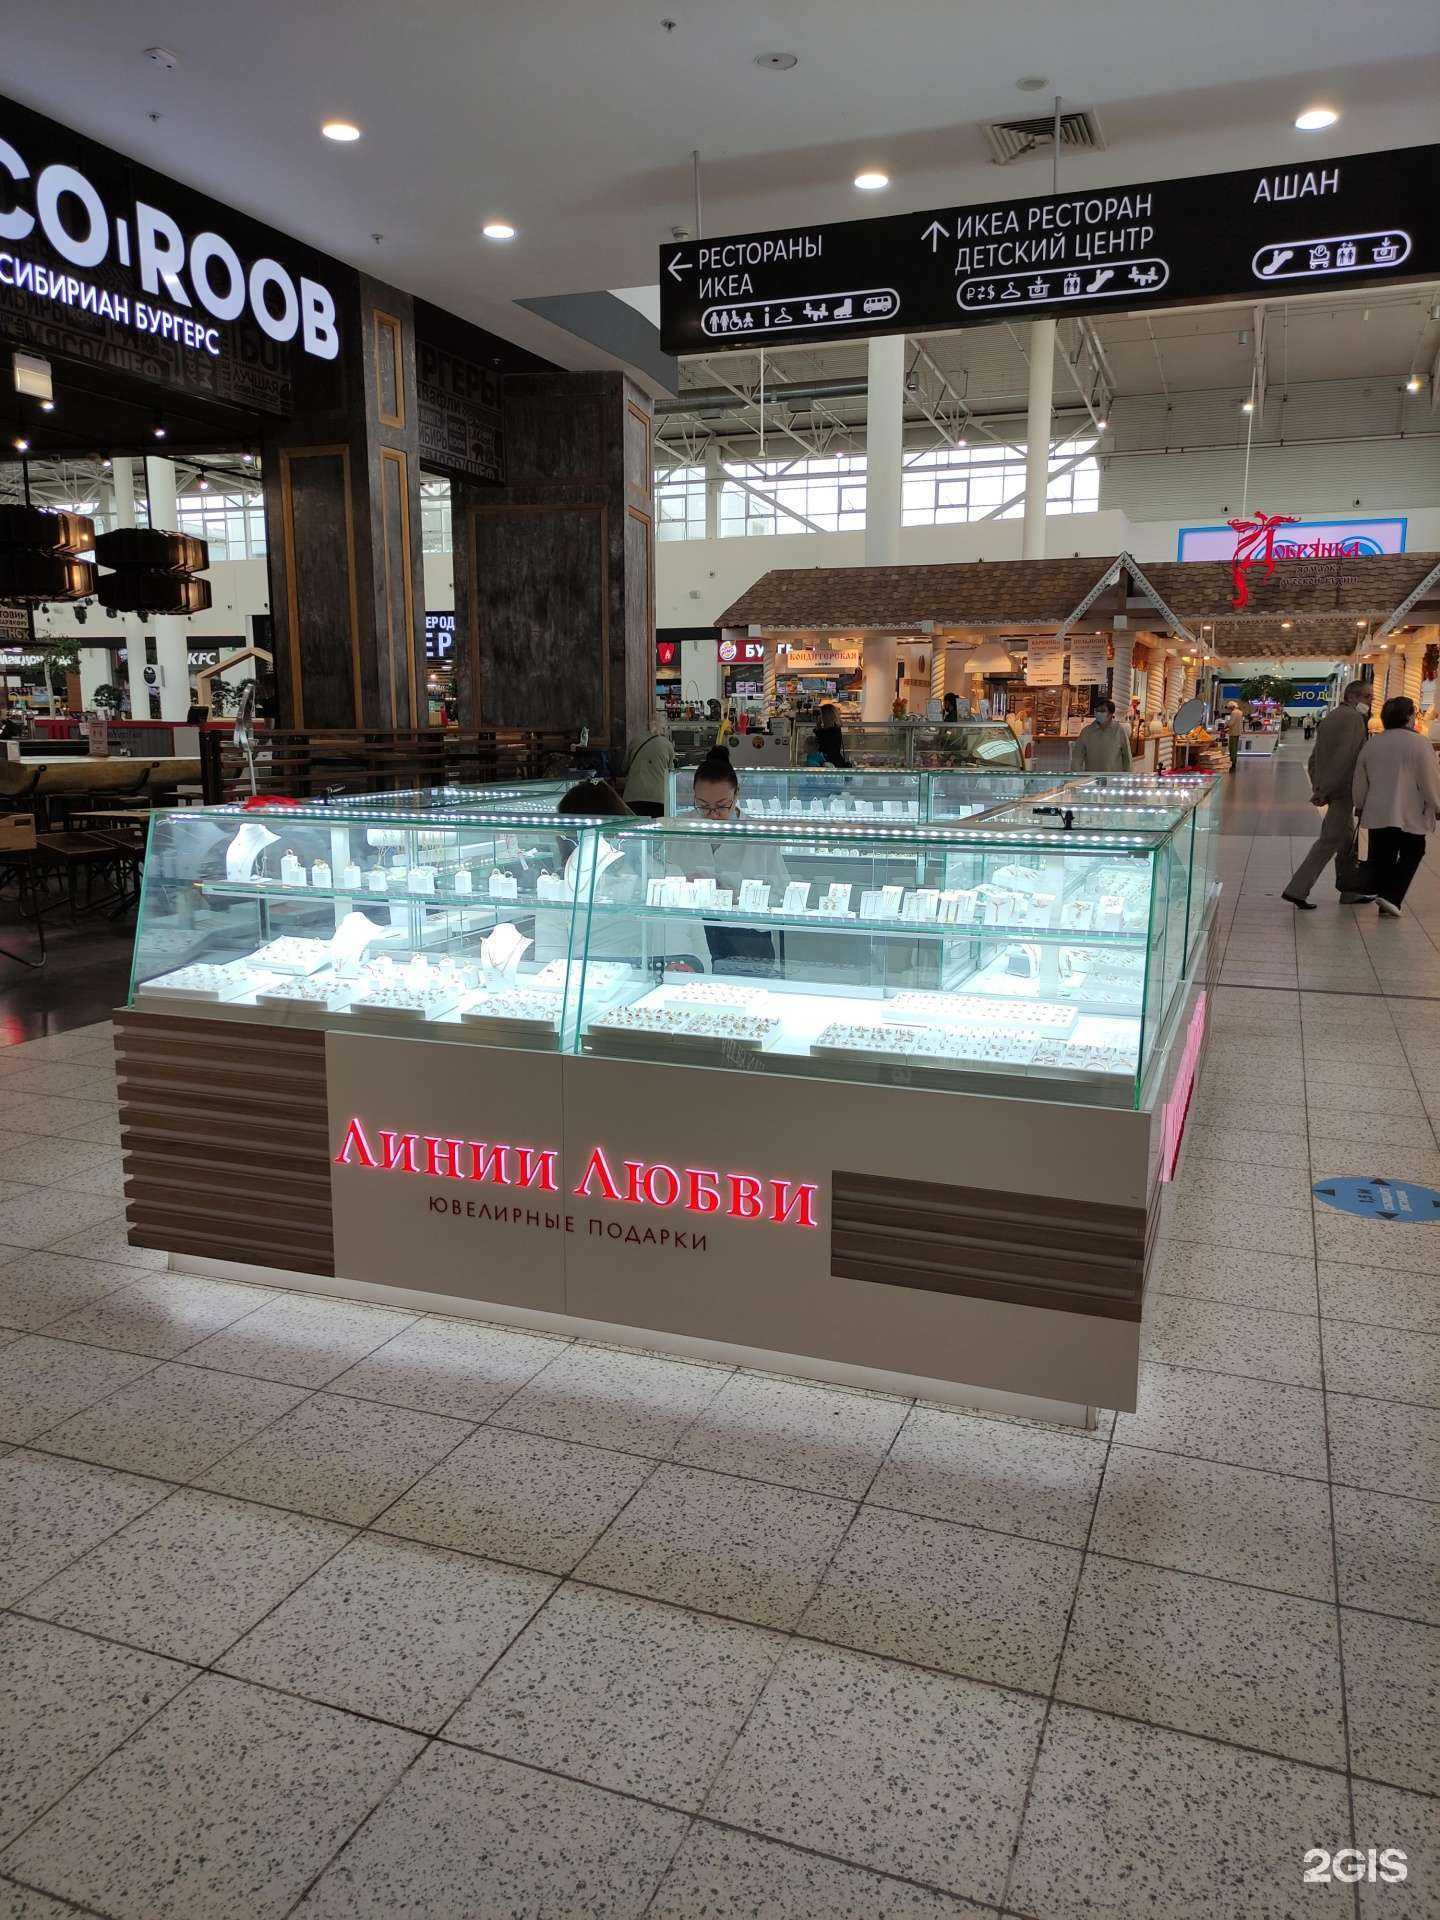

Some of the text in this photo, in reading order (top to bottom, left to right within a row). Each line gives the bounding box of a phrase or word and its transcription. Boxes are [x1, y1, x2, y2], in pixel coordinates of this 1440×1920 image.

[1253, 168, 1340, 204] АШАН
[957, 193, 1152, 240] ИКЕА РЕСТОРАН
[699, 235, 822, 270] РЕСТОРАНЫ
[955, 226, 1154, 275] ДЕТСКИЙ ЦЕНТР
[0, 253, 129, 325] СИБИРИАН
[135, 301, 220, 355] БУРГЕРС
[699, 273, 753, 299] ИКЕА
[187, 652, 217, 665] KFC
[334, 1117, 819, 1228] ЛИНИИ ЛЮБВИ
[429, 1195, 708, 1252] ЮВЕЛИРНЫЕ ПОДАРКИ
